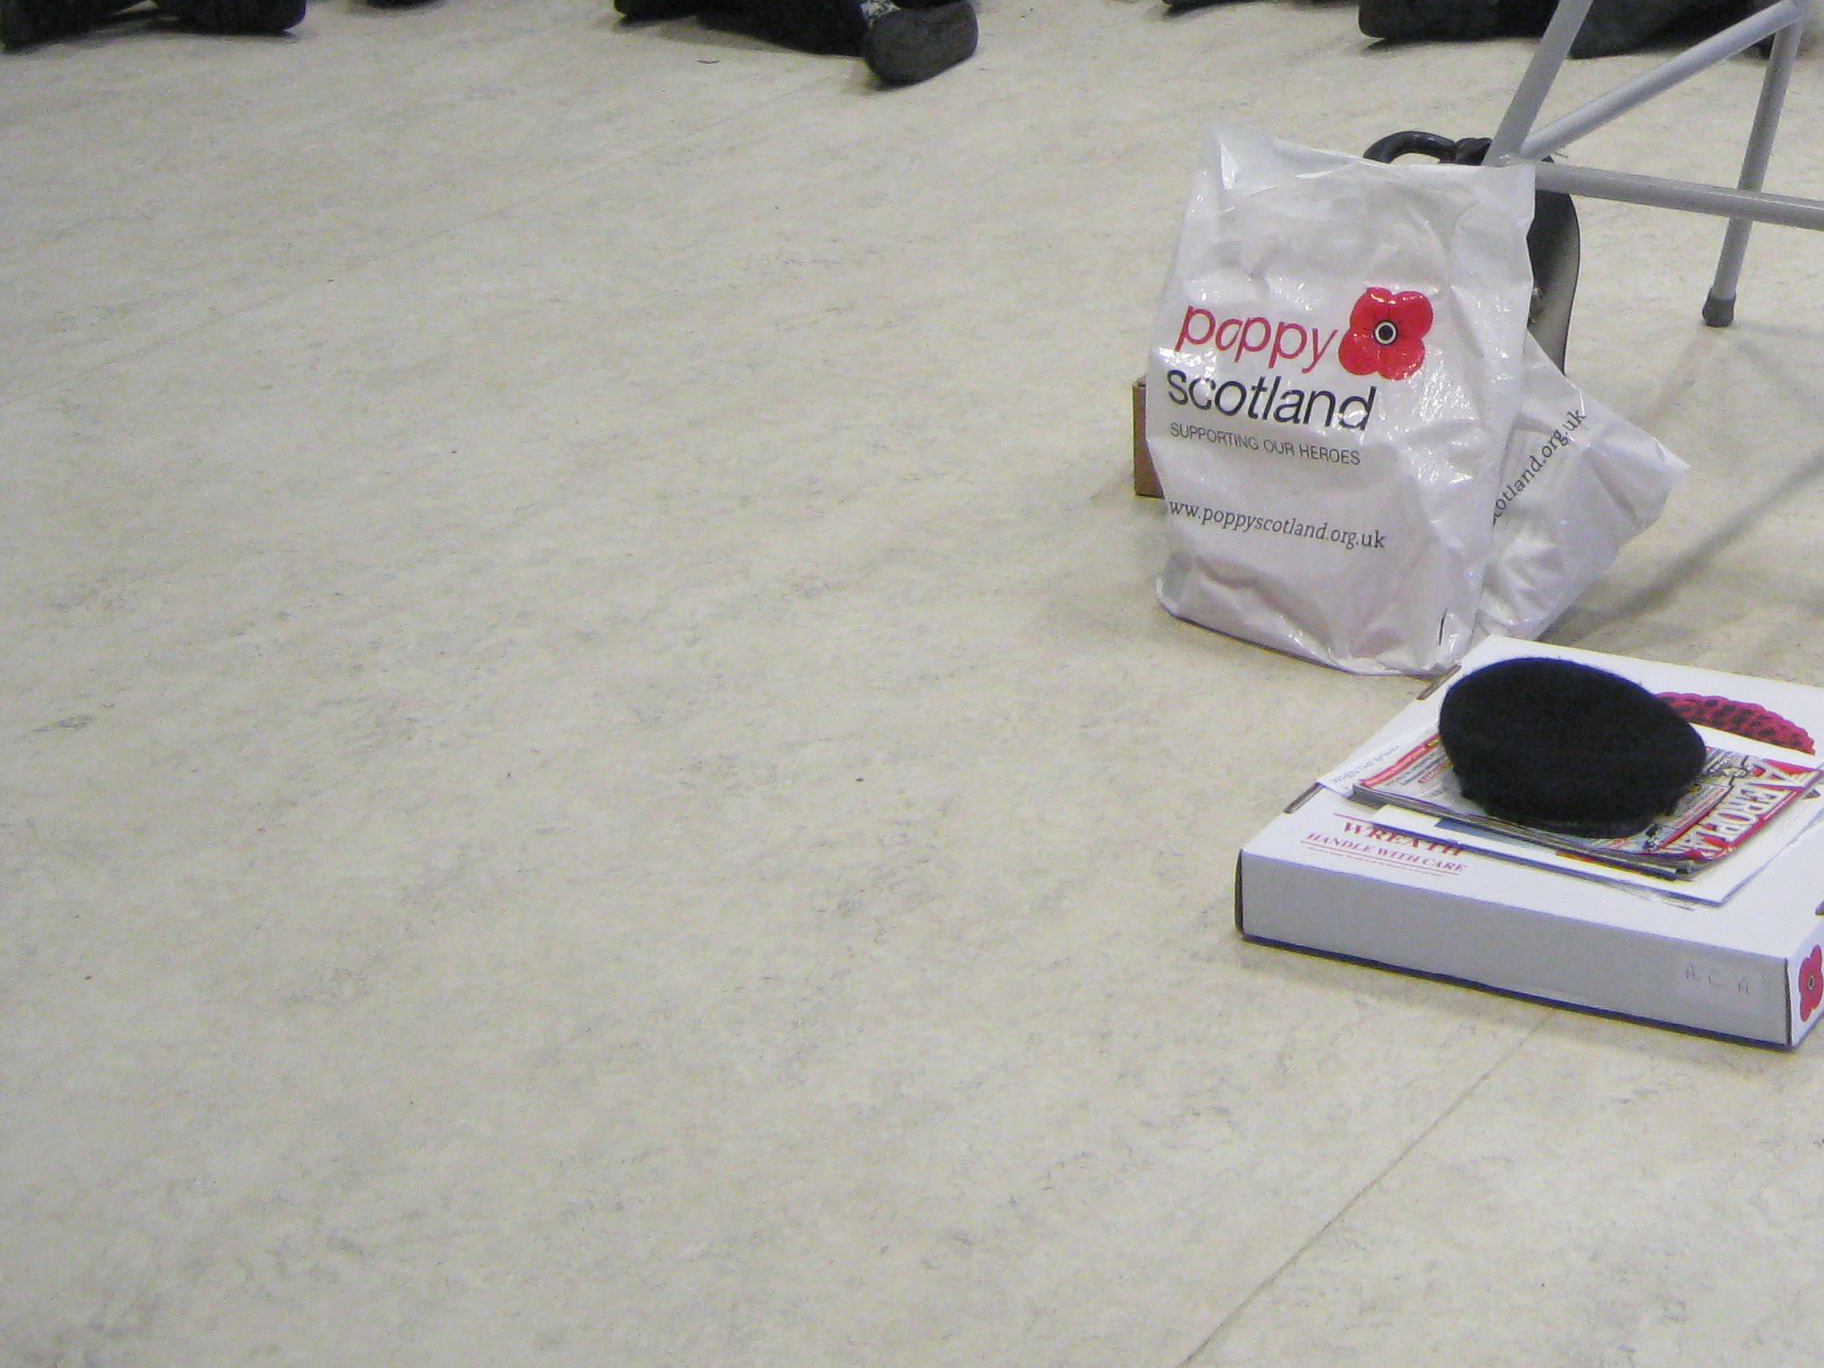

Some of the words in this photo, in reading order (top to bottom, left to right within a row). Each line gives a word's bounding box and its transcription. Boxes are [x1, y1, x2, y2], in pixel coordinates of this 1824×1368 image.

[1174, 305, 1339, 374] poppy
[1166, 369, 1377, 431] scotland
[1170, 422, 1259, 451] SUPPORTING
[1263, 438, 1295, 457] OUR
[1299, 444, 1361, 466] HEROES
[1306, 832, 1375, 854] HANDLE
[1377, 847, 1421, 863] WITH
[1422, 857, 1468, 872] CARE
